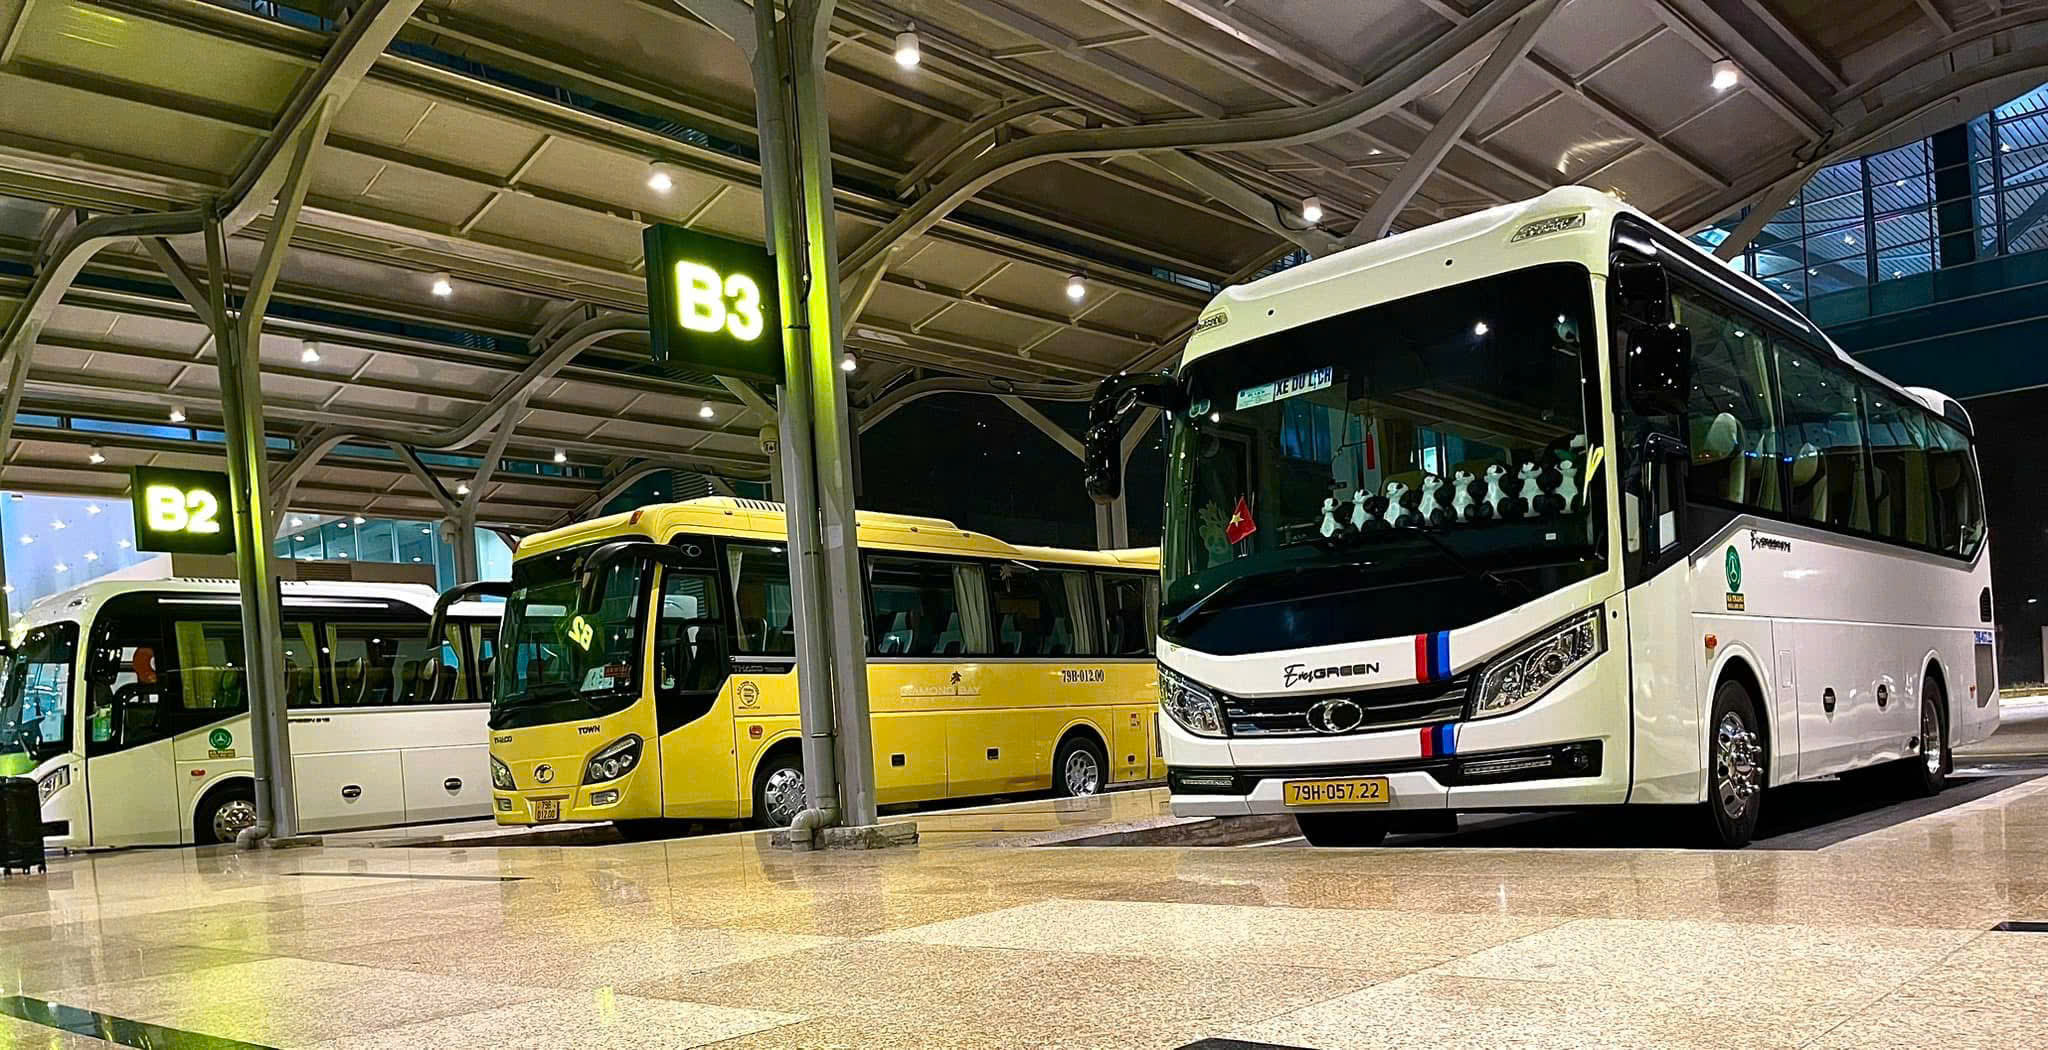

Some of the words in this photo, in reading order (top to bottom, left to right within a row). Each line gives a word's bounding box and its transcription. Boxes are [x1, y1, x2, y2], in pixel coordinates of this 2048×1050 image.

[675, 260, 764, 341] B3
[1276, 380, 1289, 396] XE
[1291, 375, 1305, 391] DU
[1308, 368, 1331, 389] LỊCH
[146, 485, 220, 534] B2
[577, 725, 601, 735] TOWN
[1292, 783, 1380, 801] 79H-057.22
